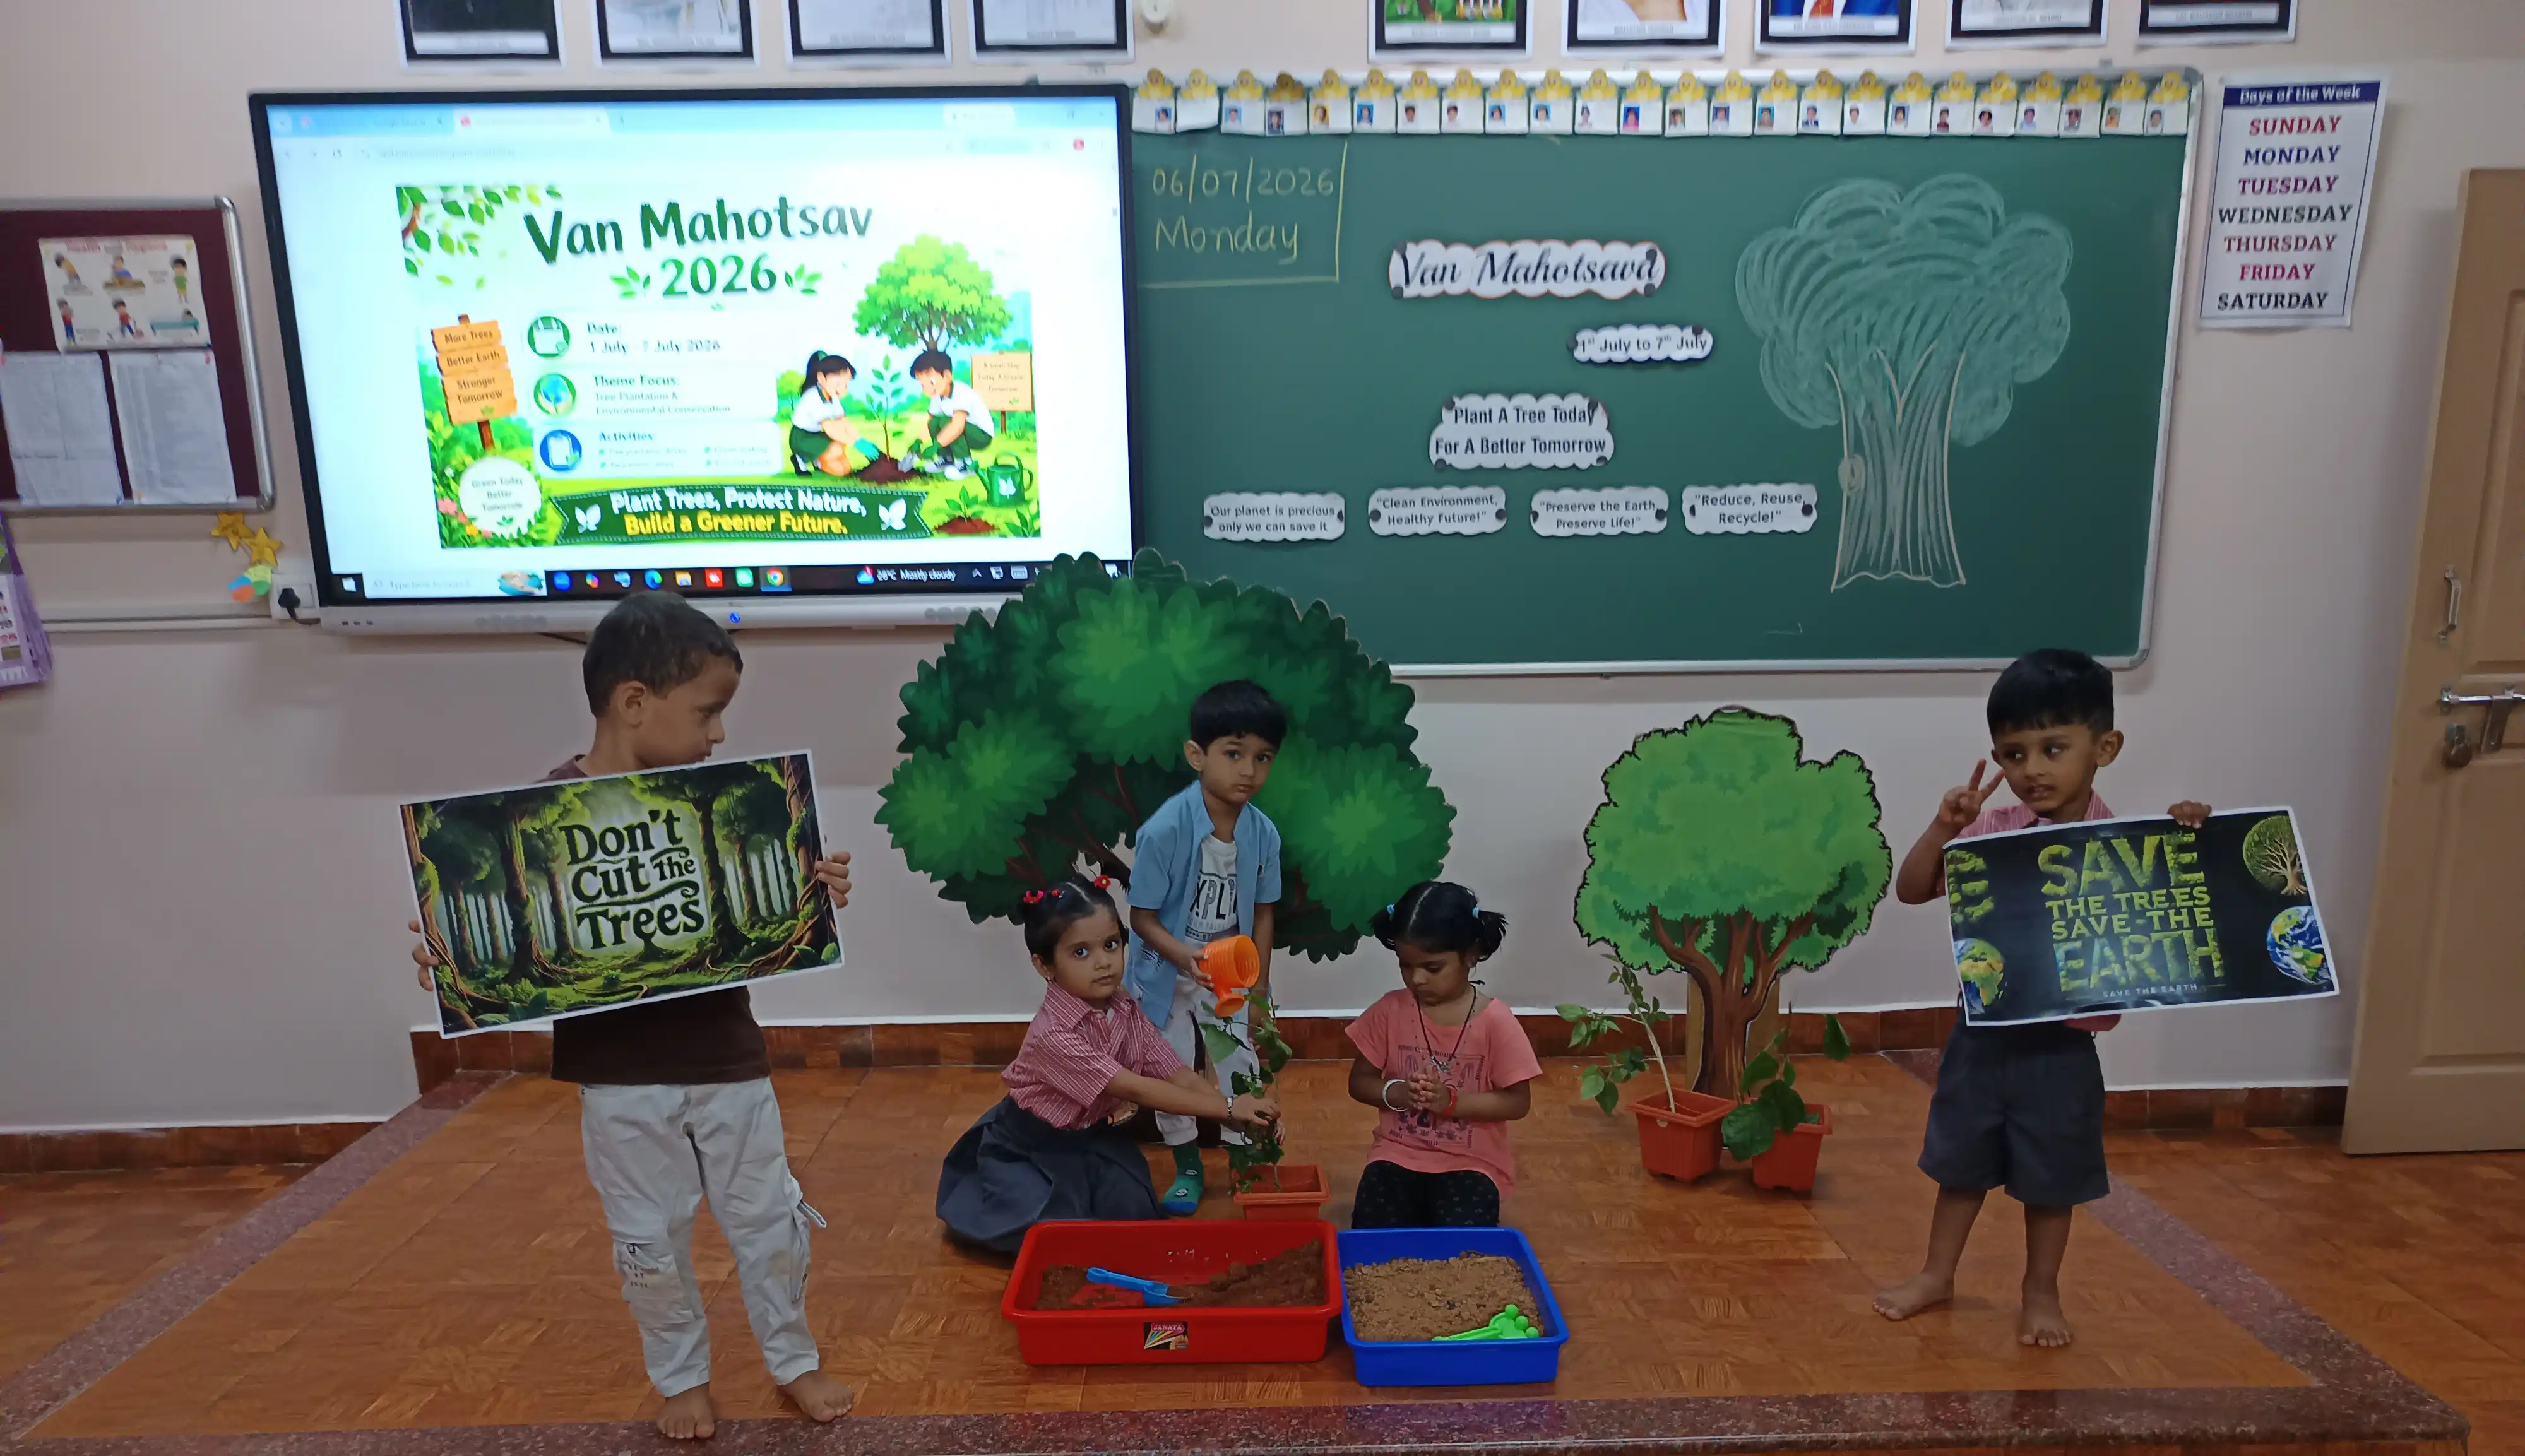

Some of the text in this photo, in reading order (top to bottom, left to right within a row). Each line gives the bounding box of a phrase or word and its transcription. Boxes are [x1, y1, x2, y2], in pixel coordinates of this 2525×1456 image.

[2240, 84, 2360, 105] Days of the Week
[2249, 115, 2342, 136] SUNDAY
[2243, 145, 2341, 167] MONDAY
[1153, 154, 1333, 203] 06/07/2026
[2238, 175, 2339, 195] TUESDAY
[2218, 204, 2353, 225] WEDNESDAY
[523, 195, 872, 266] Van Mahotsav
[1155, 209, 1298, 264] Monday
[2224, 234, 2338, 252] THURSDAY
[661, 253, 777, 299] 2026
[1401, 247, 1461, 287] Van
[2239, 263, 2315, 281] FRIDAY
[2217, 292, 2328, 311] SATURDAY
[444, 329, 493, 344] More Trees
[1600, 338, 1631, 354] July
[1637, 338, 1651, 350] to
[1656, 334, 1672, 350] 7th
[1677, 334, 1707, 353] July
[446, 350, 500, 367] Better Earth
[457, 376, 496, 390] Stronger
[458, 389, 503, 405] Tomorrow
[1454, 405, 1595, 426] Plant A Tree Today
[1435, 435, 1605, 455] For A Better Tomorrow
[472, 475, 524, 489] Green Today
[487, 489, 512, 500] Better
[610, 487, 867, 516] Plant Trees, Protect Nature,
[481, 500, 523, 512] Tomorrow
[1235, 504, 1270, 518] planet
[1275, 504, 1284, 516] is
[1288, 504, 1335, 518] precious
[1600, 500, 1620, 511] the
[624, 510, 848, 536] Build a Greener Future.
[1218, 521, 1328, 534] only we can save it
[1388, 513, 1434, 526] Healthy
[1556, 518, 1606, 529] Preserve
[557, 808, 684, 867] Don't
[2037, 831, 2206, 897] SAVE
[571, 856, 651, 903] Cut
[2045, 886, 2211, 920] THE TREES
[574, 899, 705, 950] Trees
[2052, 907, 2214, 940] SAVE THE
[2053, 928, 2225, 992] EARTH
[2103, 983, 2197, 998] SAVE THE EARTH
